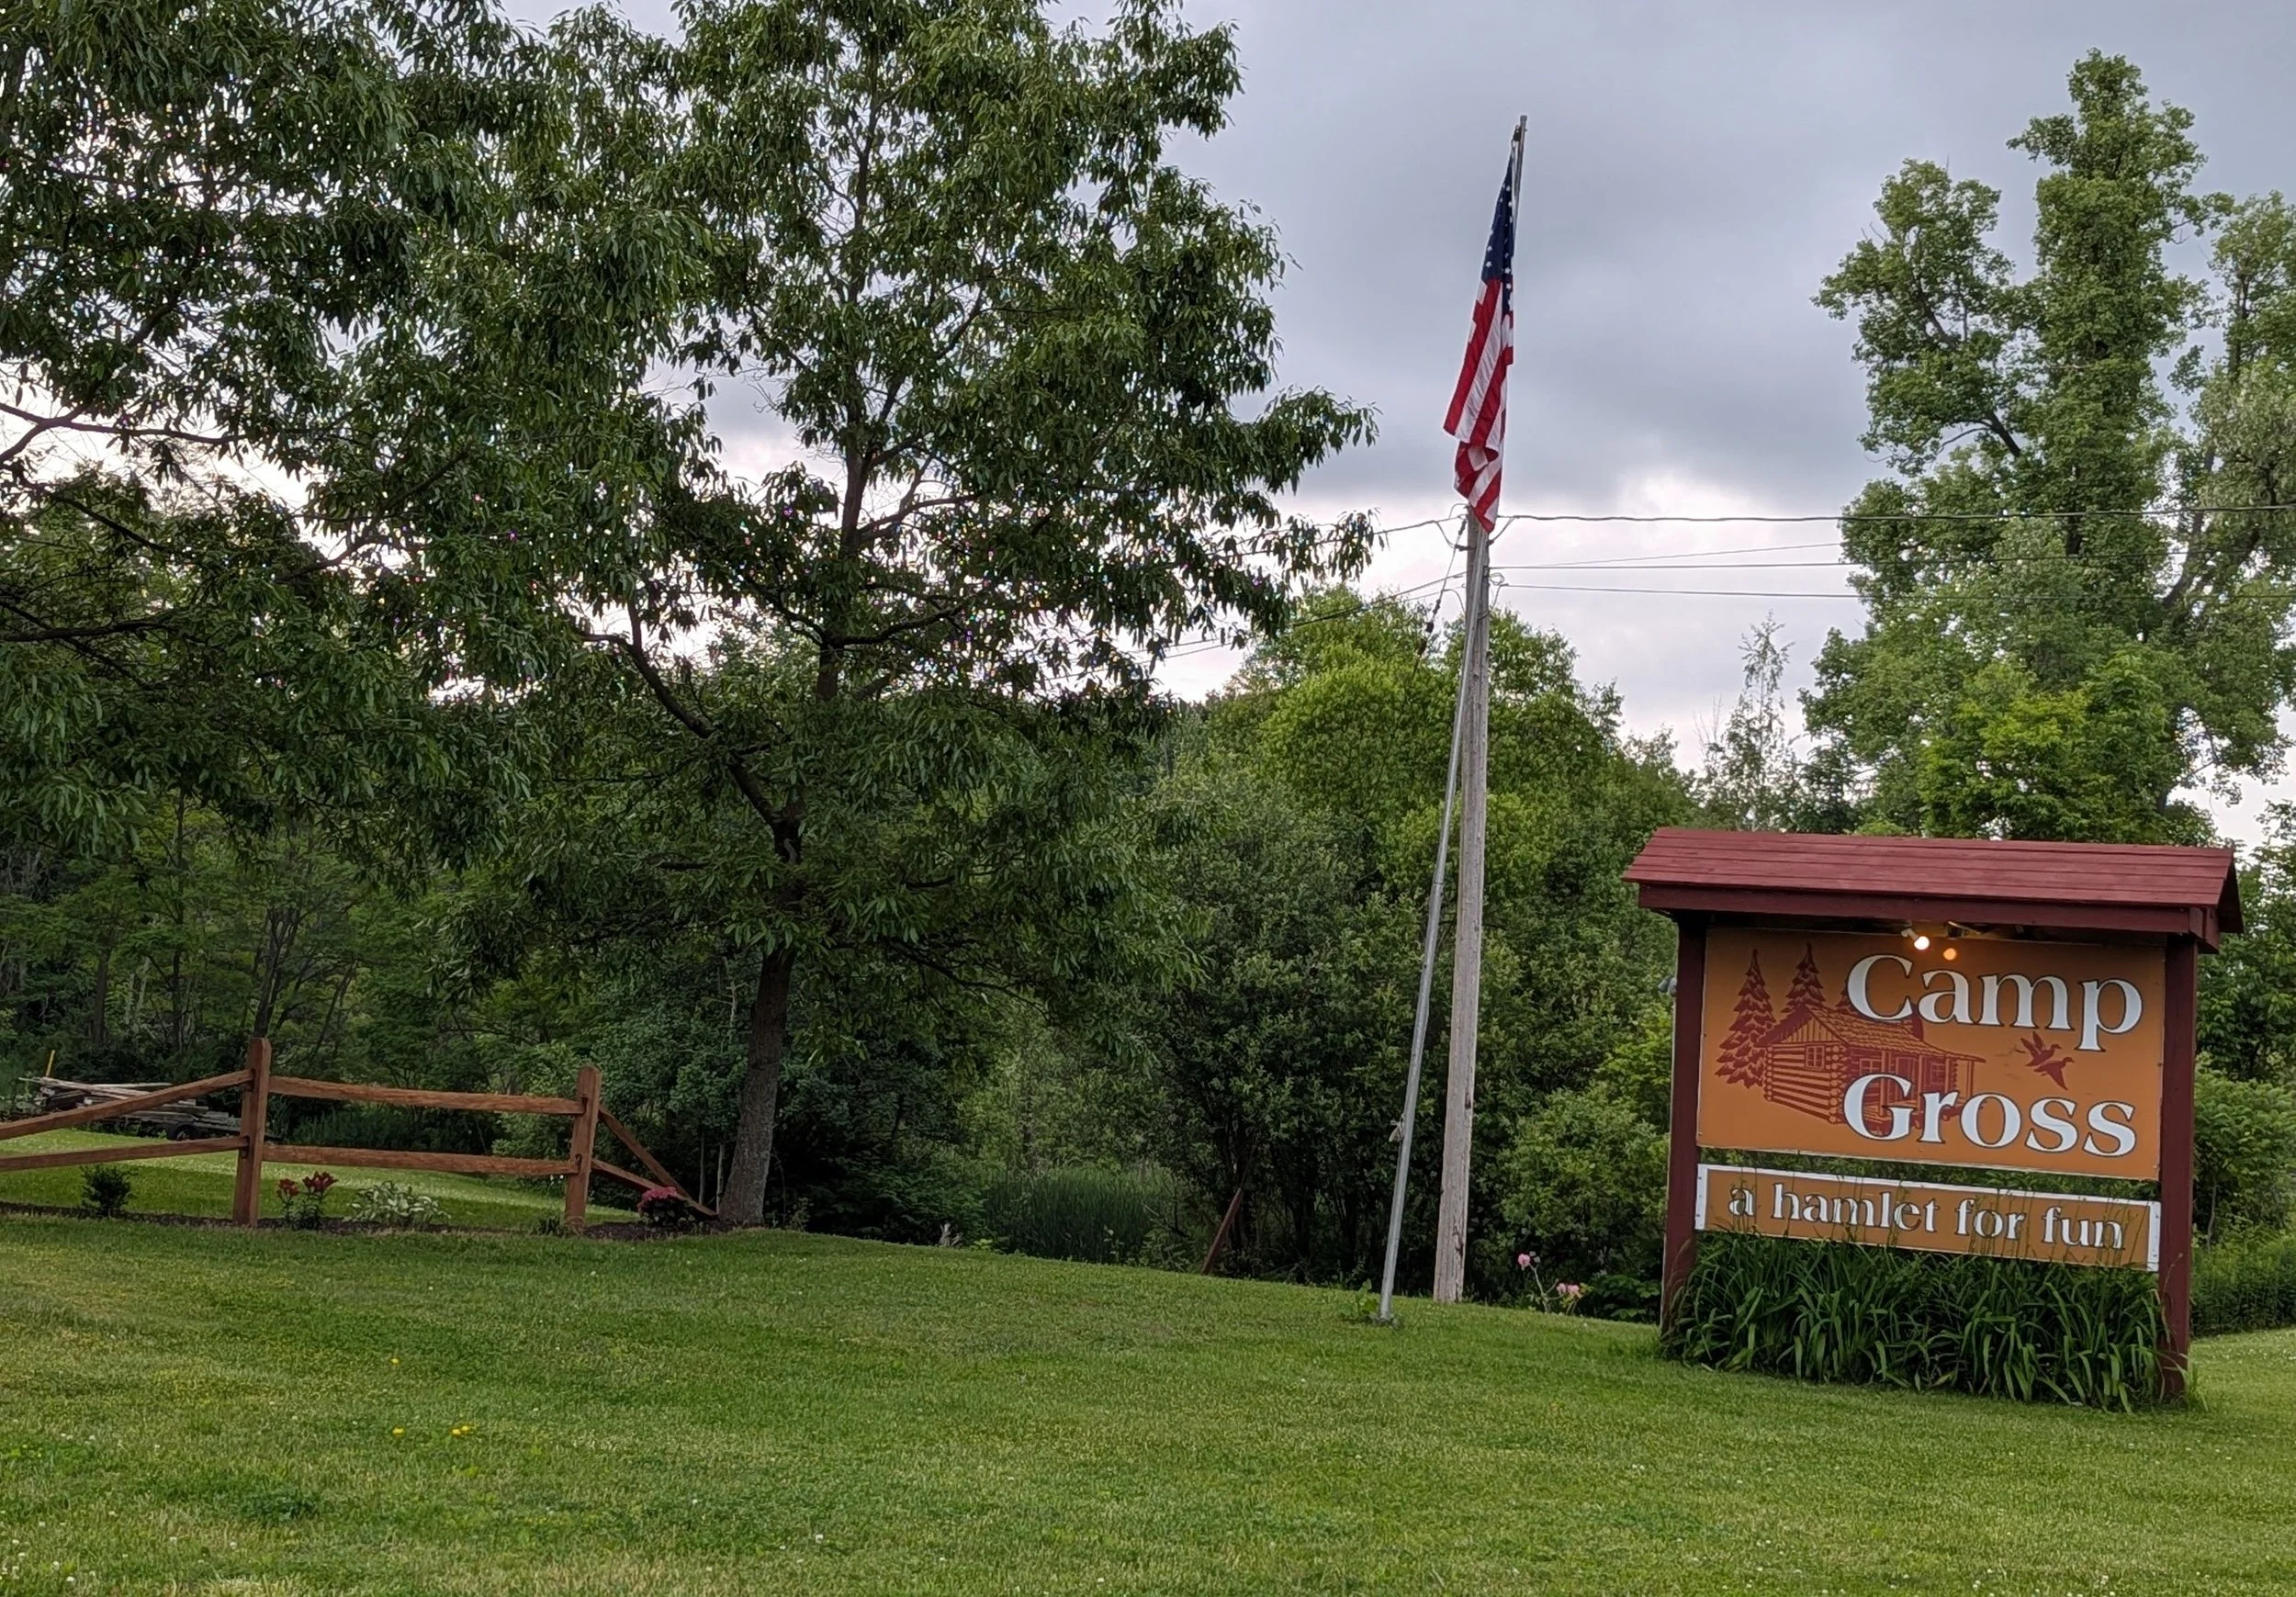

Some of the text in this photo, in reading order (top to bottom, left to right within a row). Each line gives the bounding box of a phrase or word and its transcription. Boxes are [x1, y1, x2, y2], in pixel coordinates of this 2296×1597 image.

[1846, 954, 2143, 1052] Camp
[1843, 1073, 2136, 1157] Gross
[1728, 1183, 2123, 1250] a hamlet for fun
